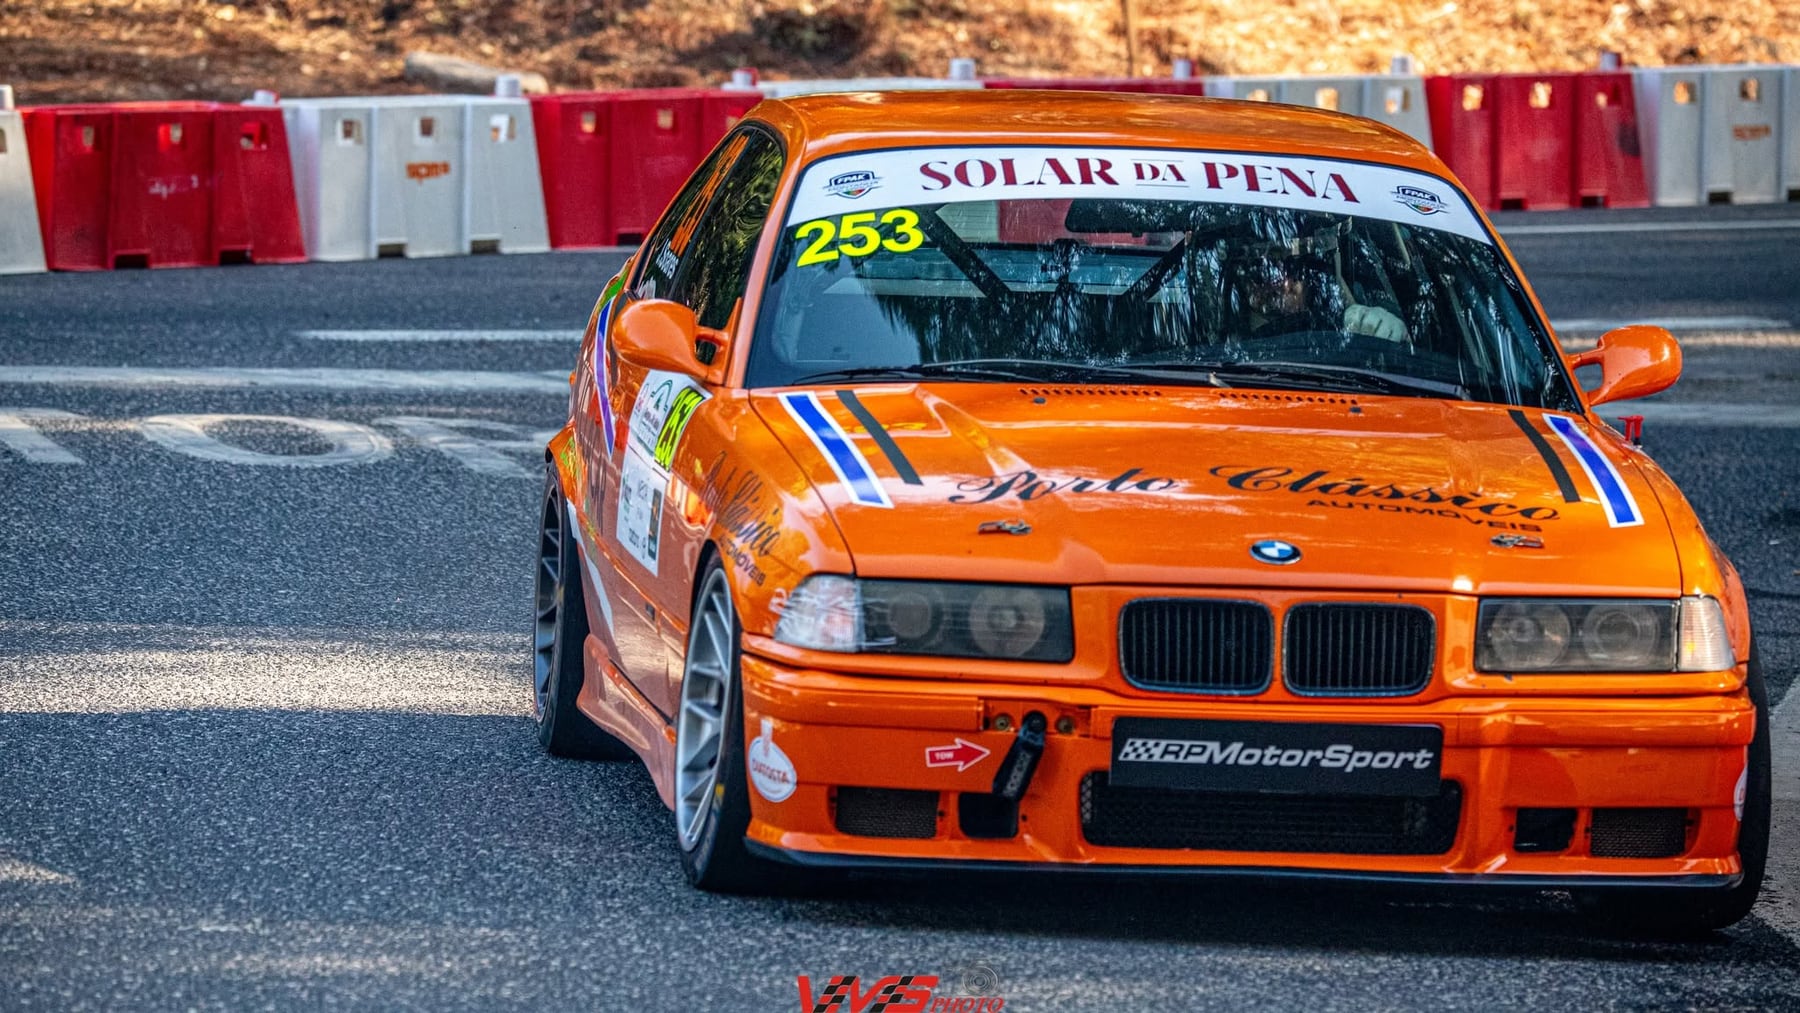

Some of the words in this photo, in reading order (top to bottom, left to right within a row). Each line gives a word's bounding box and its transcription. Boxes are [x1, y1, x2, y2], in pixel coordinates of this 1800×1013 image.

[919, 158, 1120, 191] SOLAR
[1133, 162, 1188, 183] DA
[1201, 161, 1361, 204] PENA
[795, 208, 925, 268] 253
[947, 466, 1180, 504] Porto
[1208, 464, 1562, 521] Clássico
